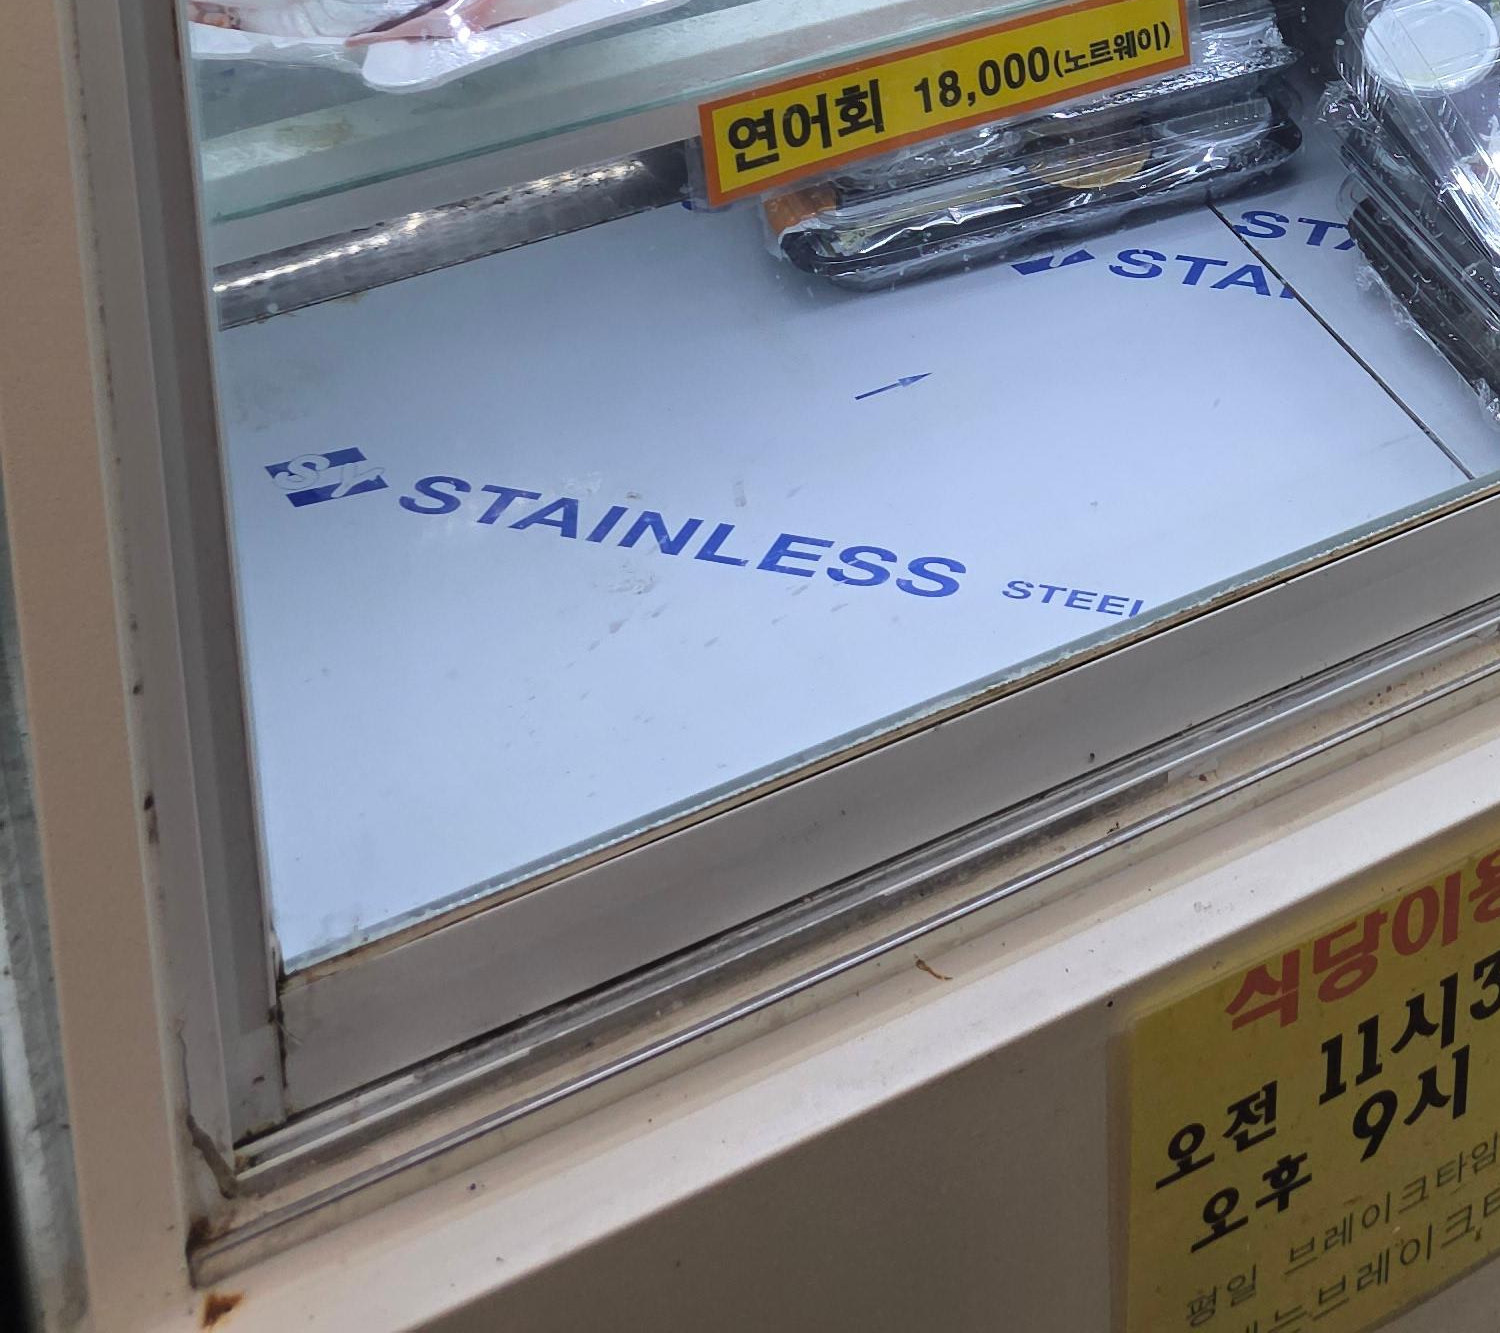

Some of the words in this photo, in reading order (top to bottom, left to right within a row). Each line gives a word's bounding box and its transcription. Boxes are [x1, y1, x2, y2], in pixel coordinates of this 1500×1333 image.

[727, 77, 886, 174] 연어회
[914, 21, 1172, 115] 18,000(노르웨이)
[399, 475, 967, 598] STAINLESS
[1155, 1080, 1280, 1191] 오전
[1191, 1153, 1313, 1253] 오후
[1352, 1044, 1472, 1163] 9시
[1186, 1264, 1258, 1328] 평일
[1284, 1131, 1499, 1276] 브레이크타임
